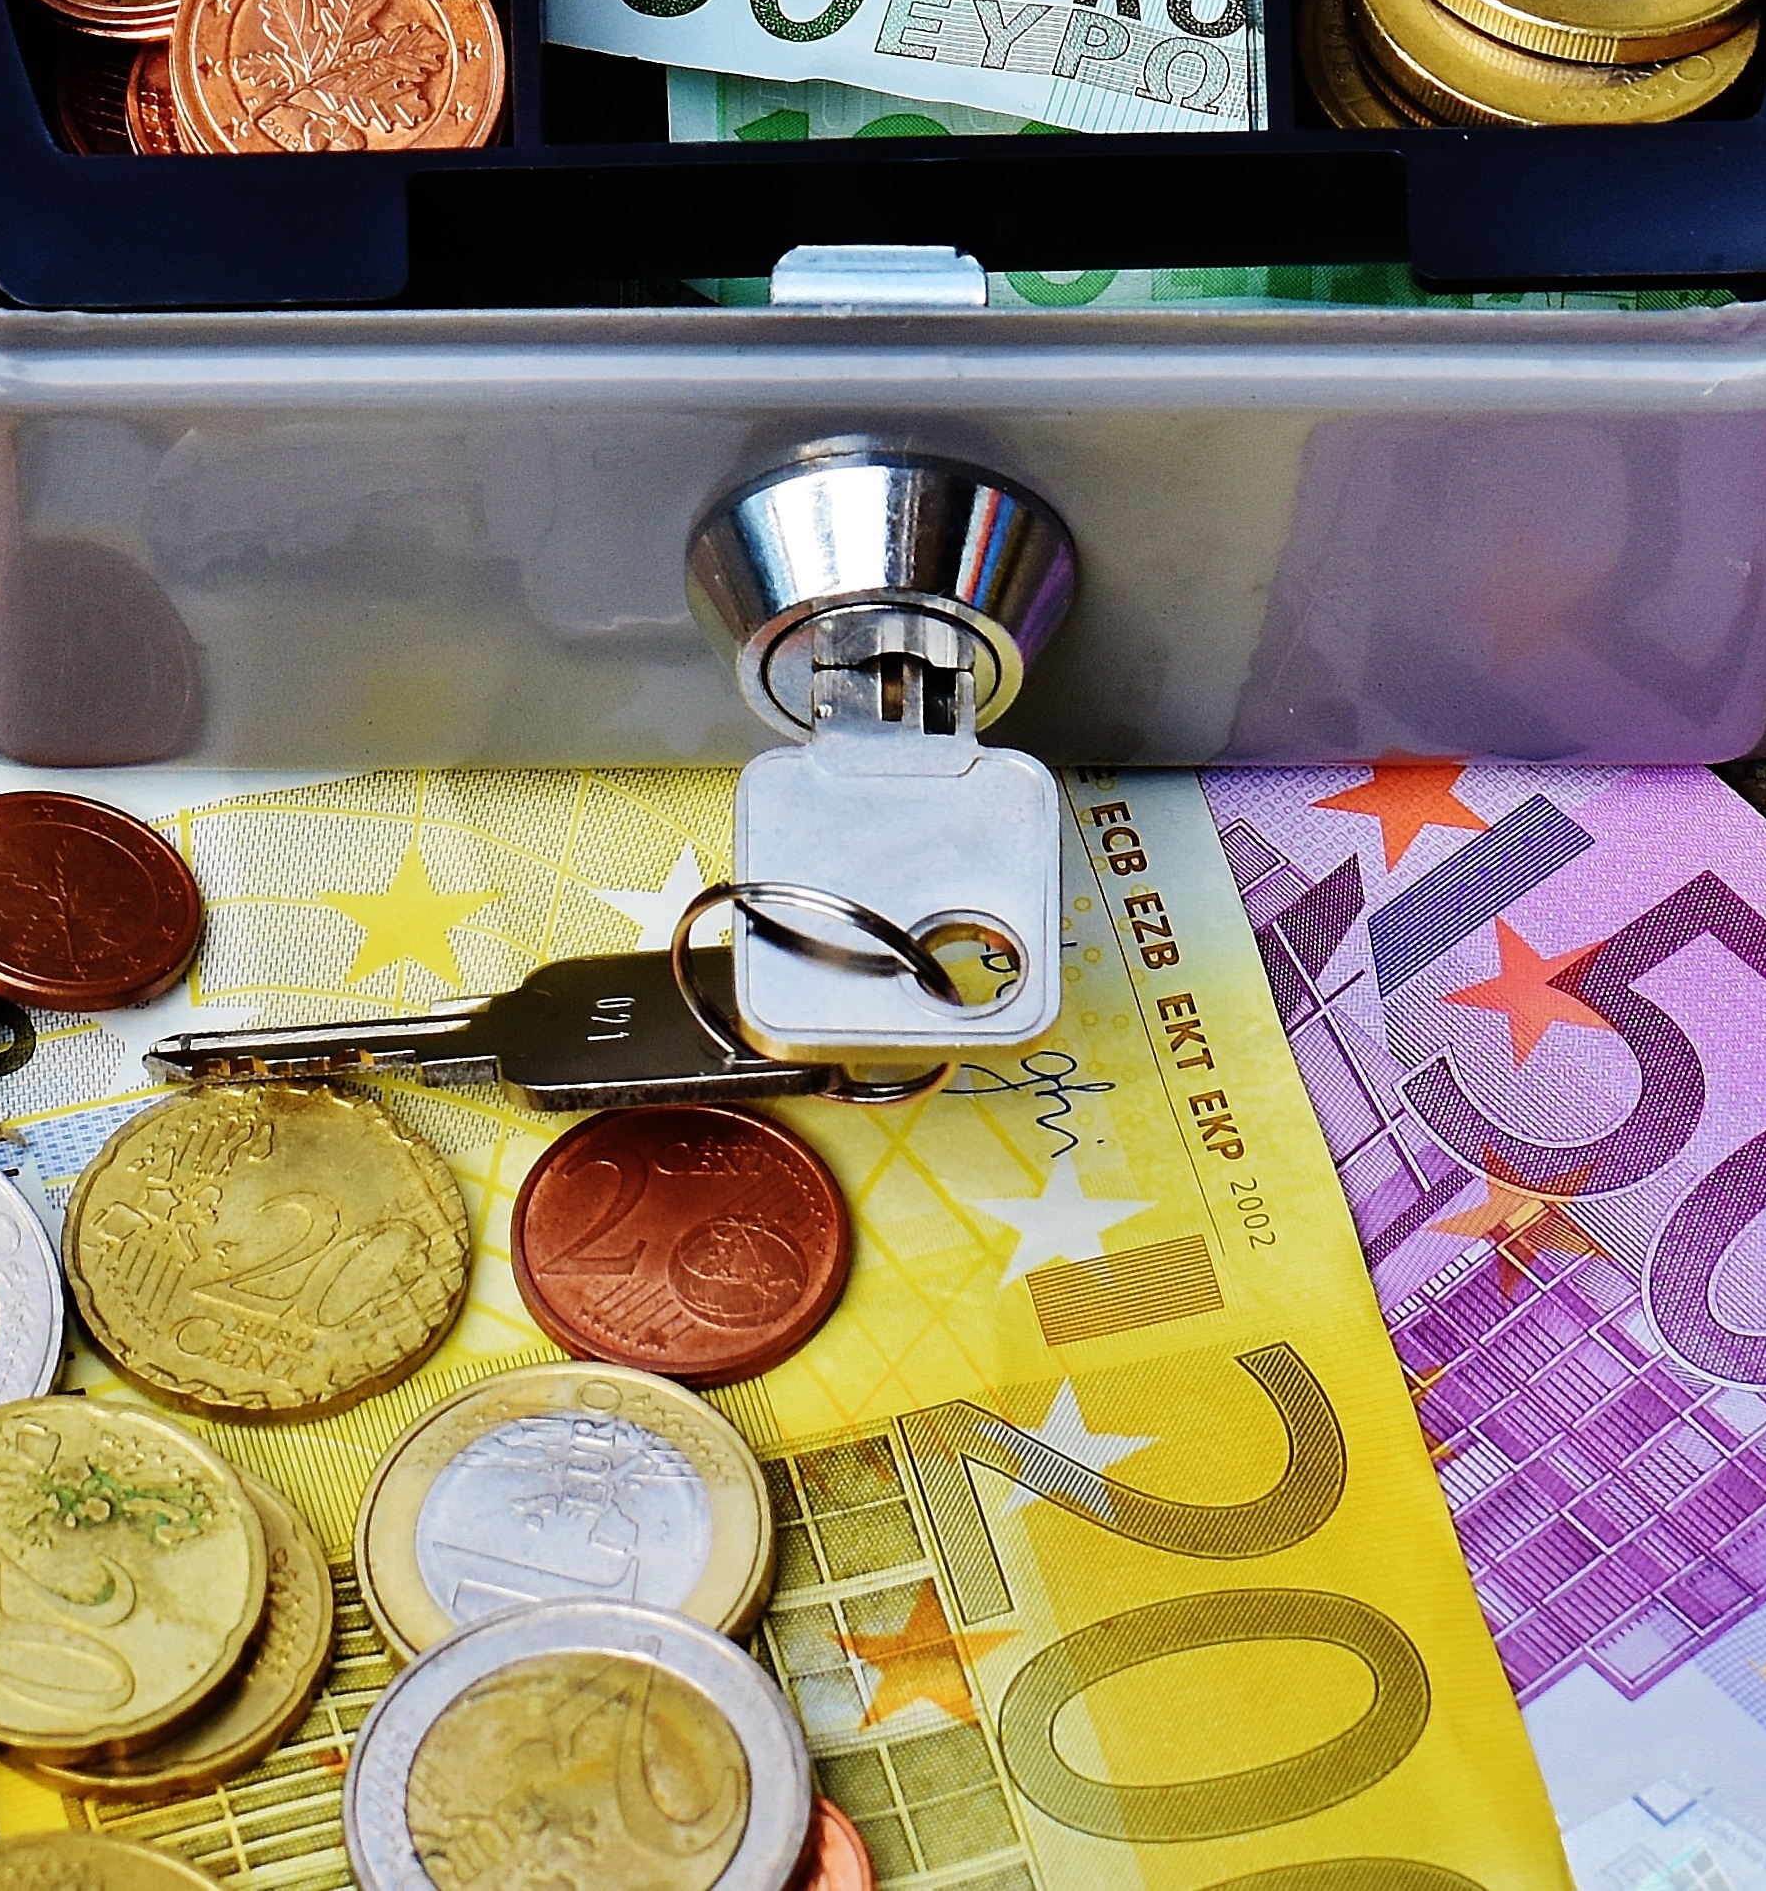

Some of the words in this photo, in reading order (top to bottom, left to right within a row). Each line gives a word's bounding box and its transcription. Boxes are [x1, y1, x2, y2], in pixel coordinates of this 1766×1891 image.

[1089, 800, 1148, 877] ECB
[1123, 890, 1182, 972] EZB
[1155, 991, 1215, 1072] EKT
[1188, 1088, 1245, 1163] EKP
[1229, 1176, 1277, 1251] 2002
[190, 1190, 432, 1329] 20
[534, 1147, 649, 1277] 2
[175, 1316, 313, 1382] CENT
[232, 1320, 315, 1353] EURO
[897, 1340, 1489, 1891] 20
